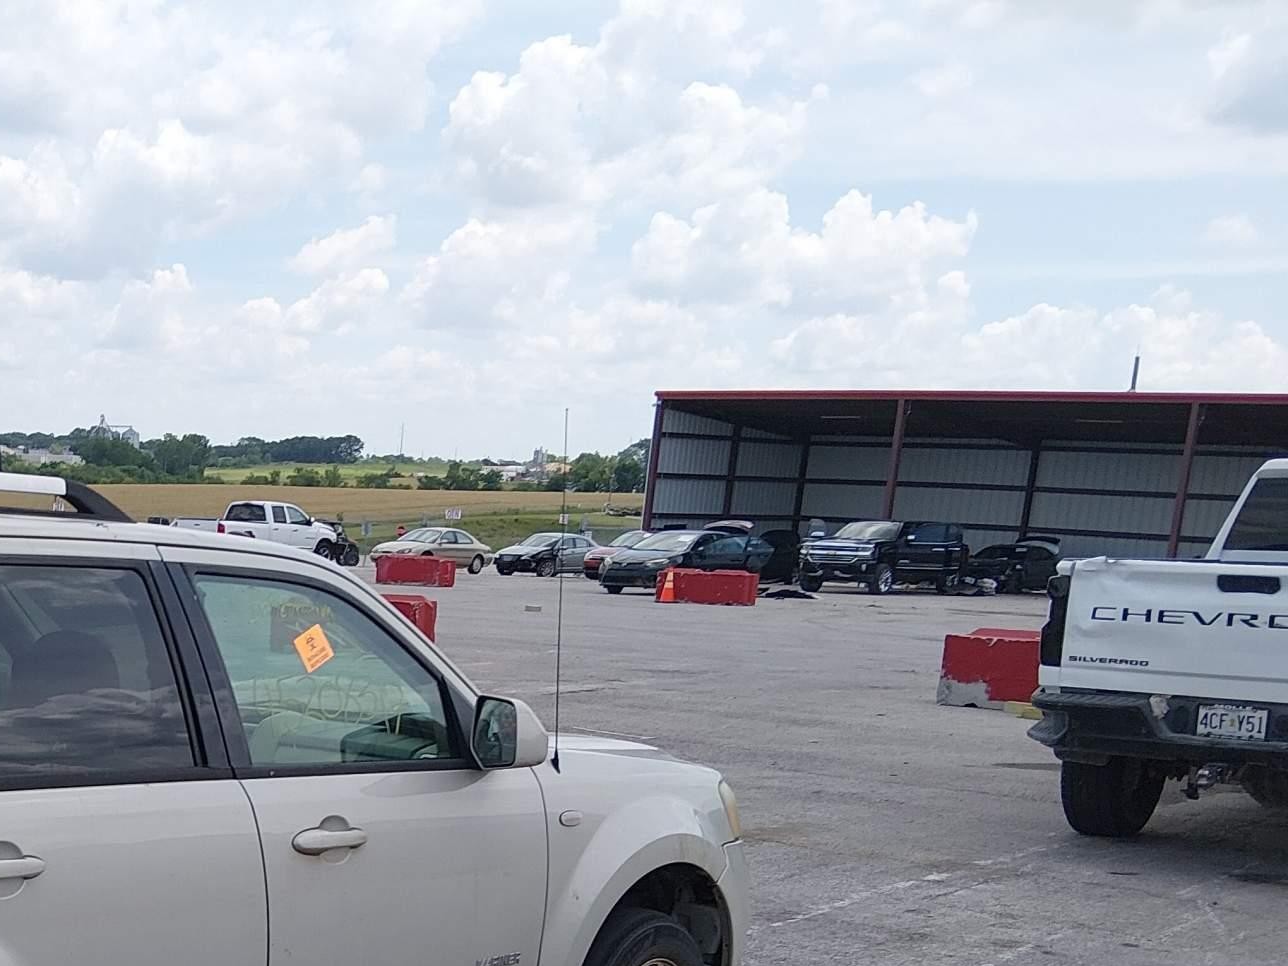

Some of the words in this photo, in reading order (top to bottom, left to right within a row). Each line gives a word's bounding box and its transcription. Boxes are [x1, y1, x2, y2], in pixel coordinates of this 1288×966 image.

[1068, 655, 1150, 667] SILVERADO
[1199, 711, 1229, 730] 4CF
[1237, 714, 1264, 734] Y51
